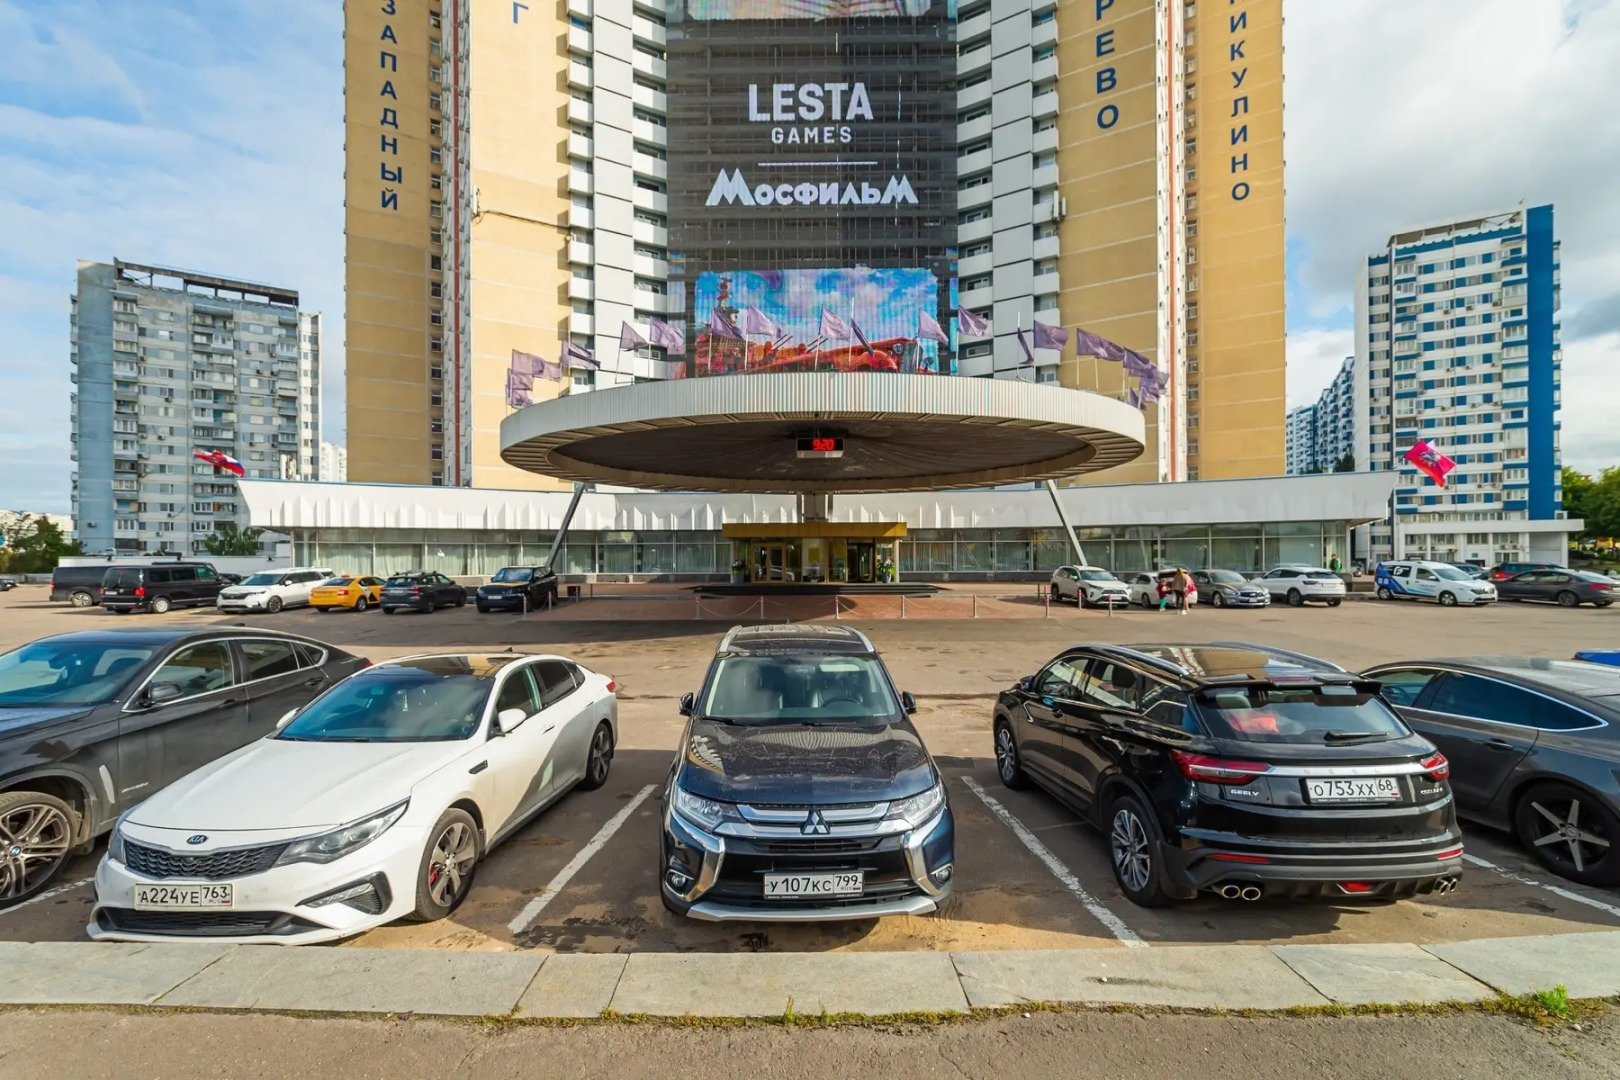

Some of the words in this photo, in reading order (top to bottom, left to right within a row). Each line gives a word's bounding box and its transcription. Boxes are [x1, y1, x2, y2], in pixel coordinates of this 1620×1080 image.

[380, 0, 402, 211] ЗАПАДНЫЙ
[749, 82, 874, 121] LESTA
[1230, 0, 1250, 201] ИКУЛИНО
[771, 126, 852, 144] GAMES
[1378, 779, 1393, 791] 68
[188, 835, 205, 843] KIA
[770, 877, 832, 893] У107КС
[835, 874, 859, 886] 799
[140, 888, 200, 904] А224УЕ
[203, 886, 228, 899] 763
